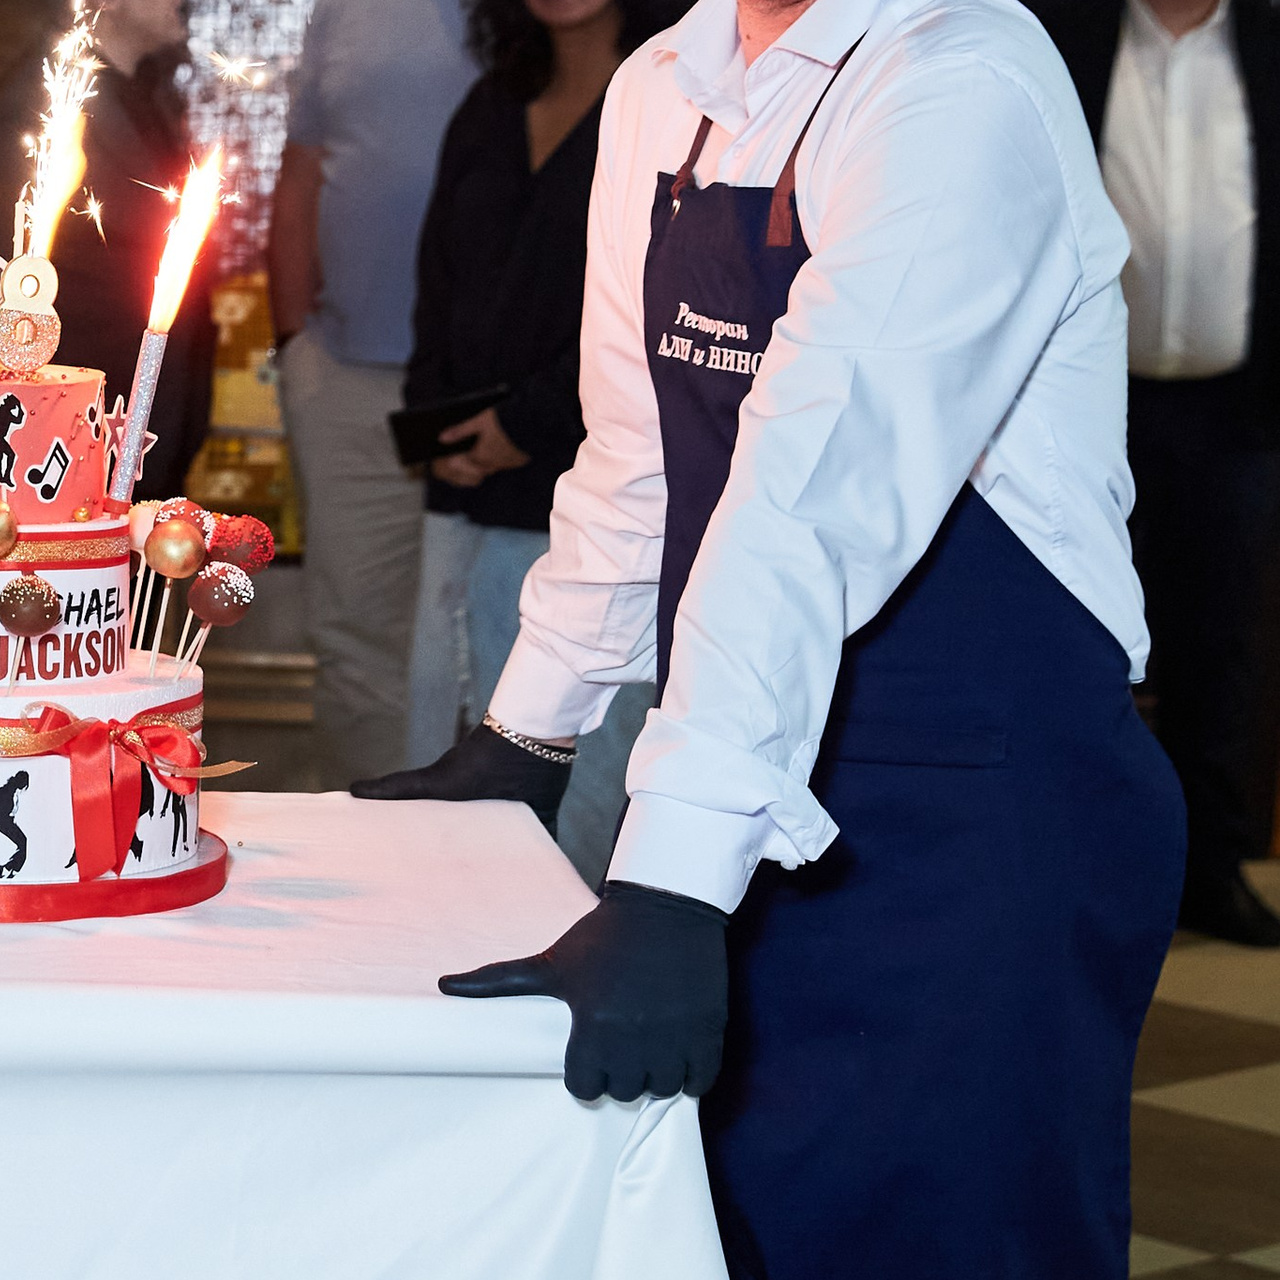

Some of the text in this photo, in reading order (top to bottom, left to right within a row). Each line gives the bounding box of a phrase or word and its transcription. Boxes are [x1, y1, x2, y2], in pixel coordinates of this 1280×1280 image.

[674, 301, 749, 341] Ресторан
[657, 332, 693, 365] АЛИ
[692, 347, 706, 366] и
